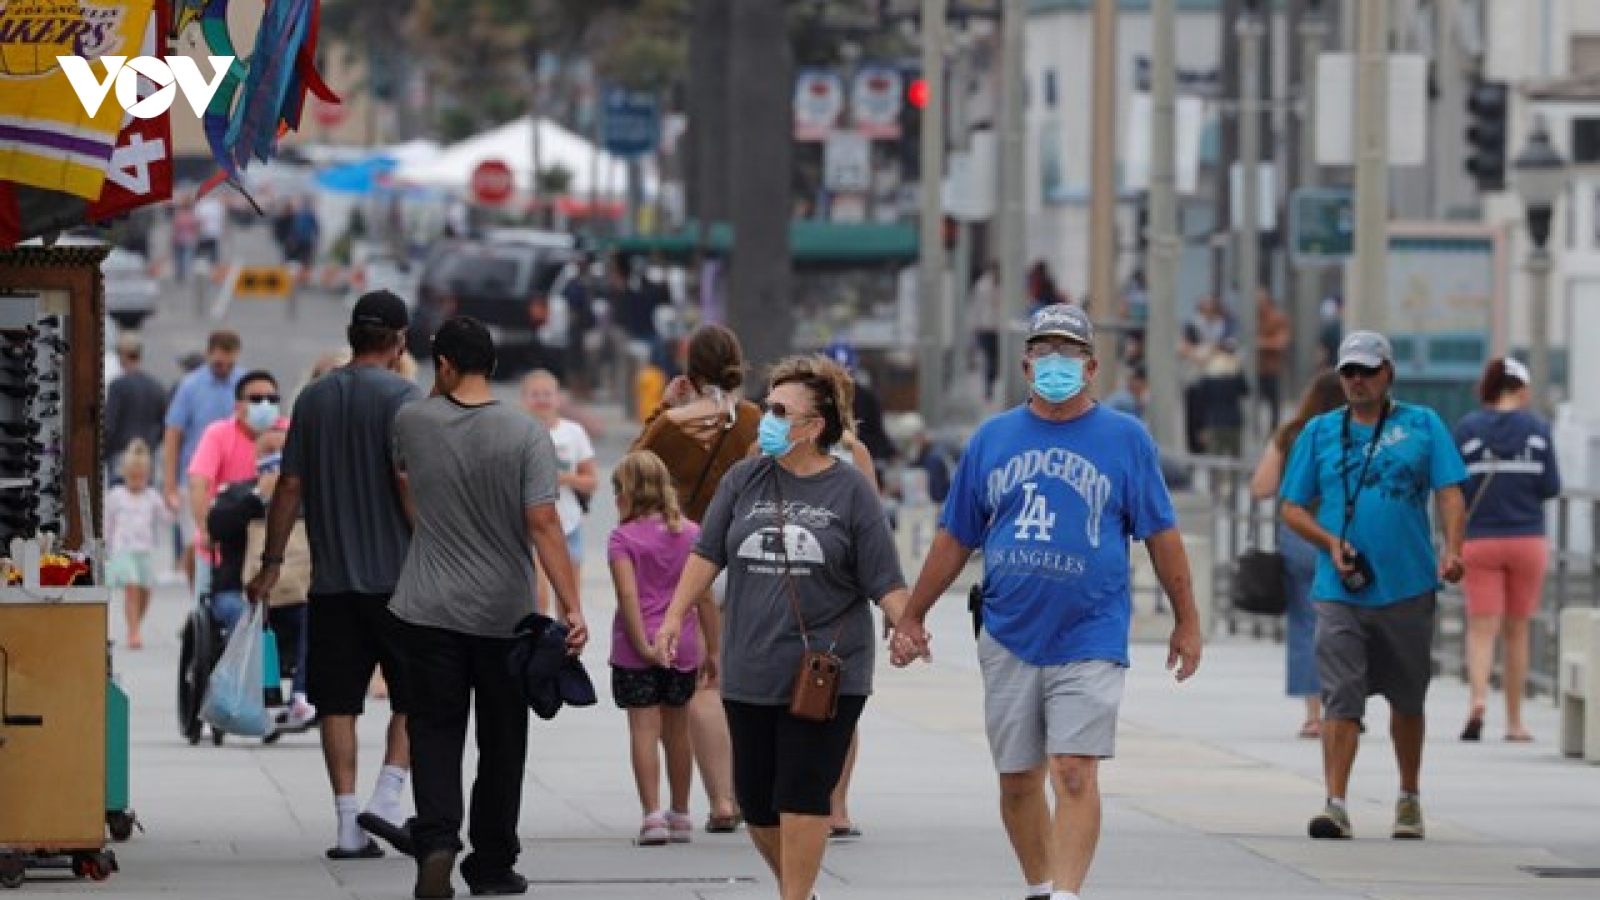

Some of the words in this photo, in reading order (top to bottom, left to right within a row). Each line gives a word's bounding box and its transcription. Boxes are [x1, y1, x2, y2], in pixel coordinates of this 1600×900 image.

[0, 19, 115, 60] AKERS
[103, 132, 166, 195] 4
[1014, 482, 1056, 541] LA
[1006, 549, 1084, 574] ANGELES
